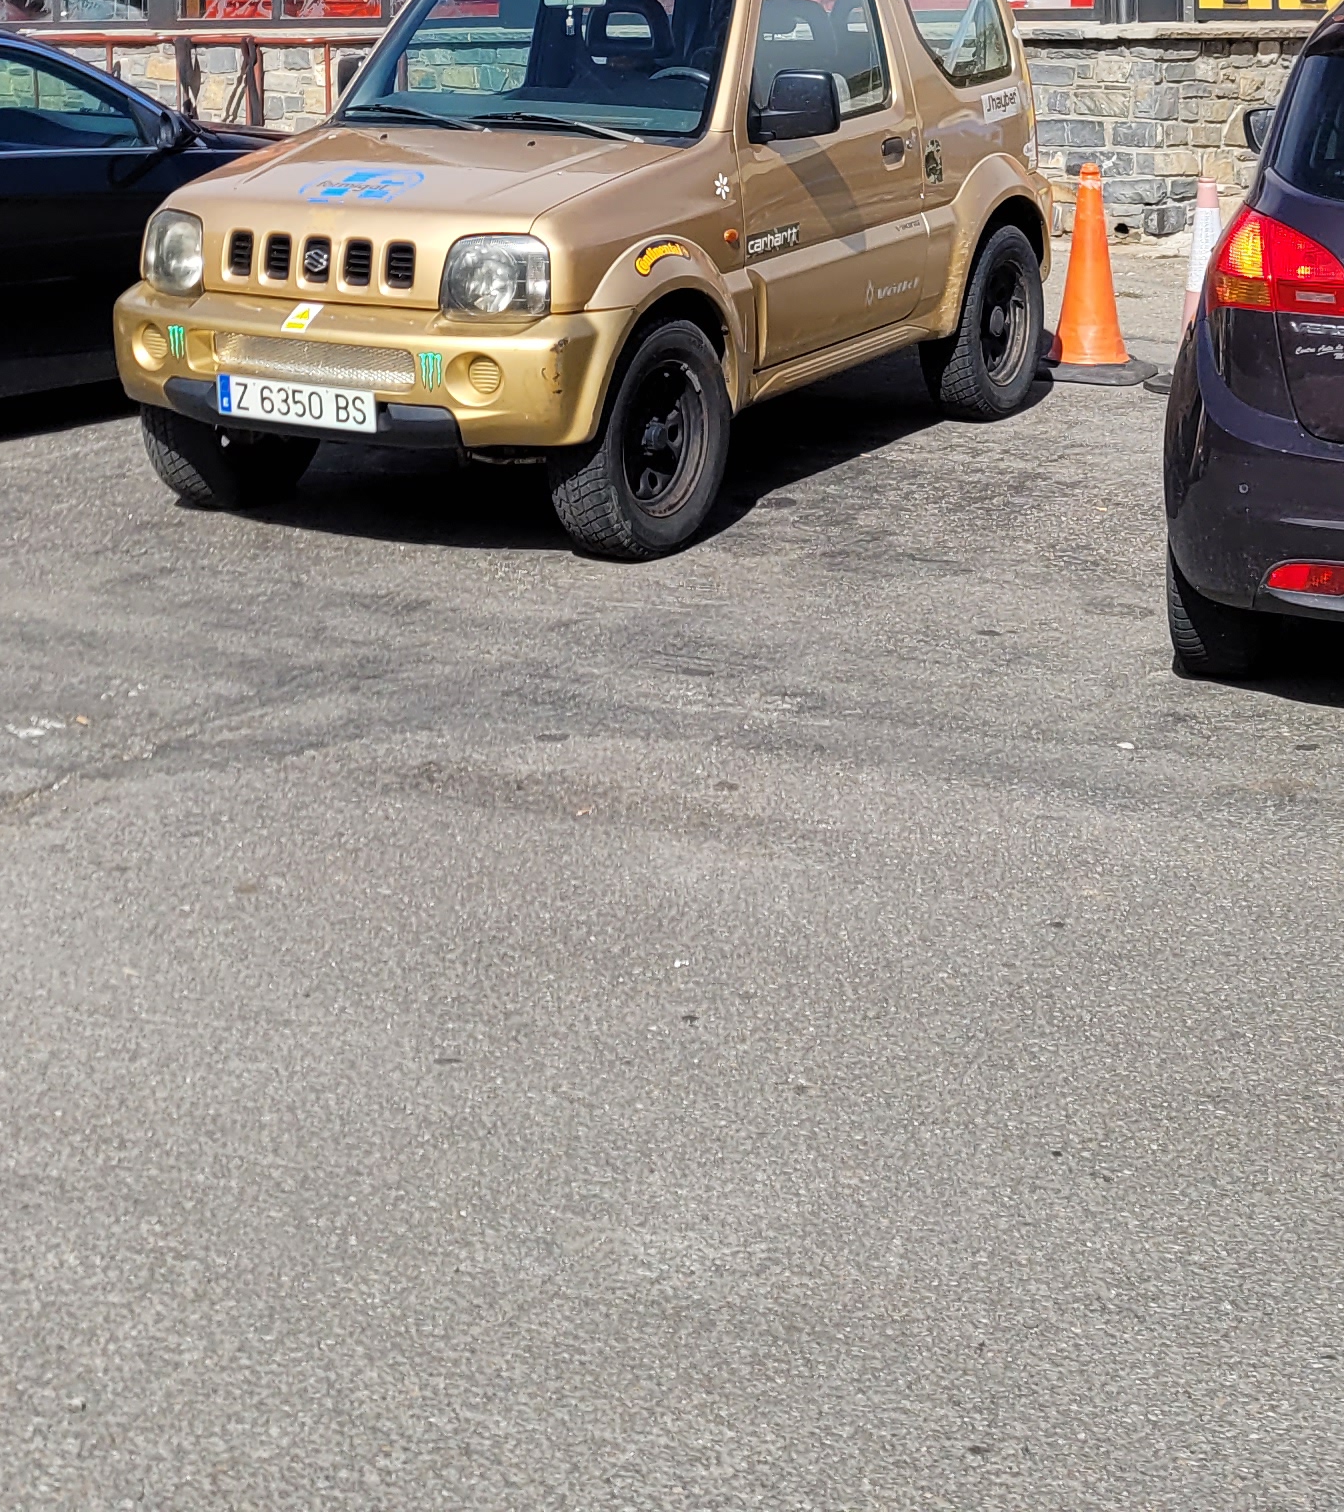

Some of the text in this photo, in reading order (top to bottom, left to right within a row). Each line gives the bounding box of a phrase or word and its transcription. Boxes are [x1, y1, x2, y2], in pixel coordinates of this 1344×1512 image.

[236, 382, 367, 425] Z 6350 BS
